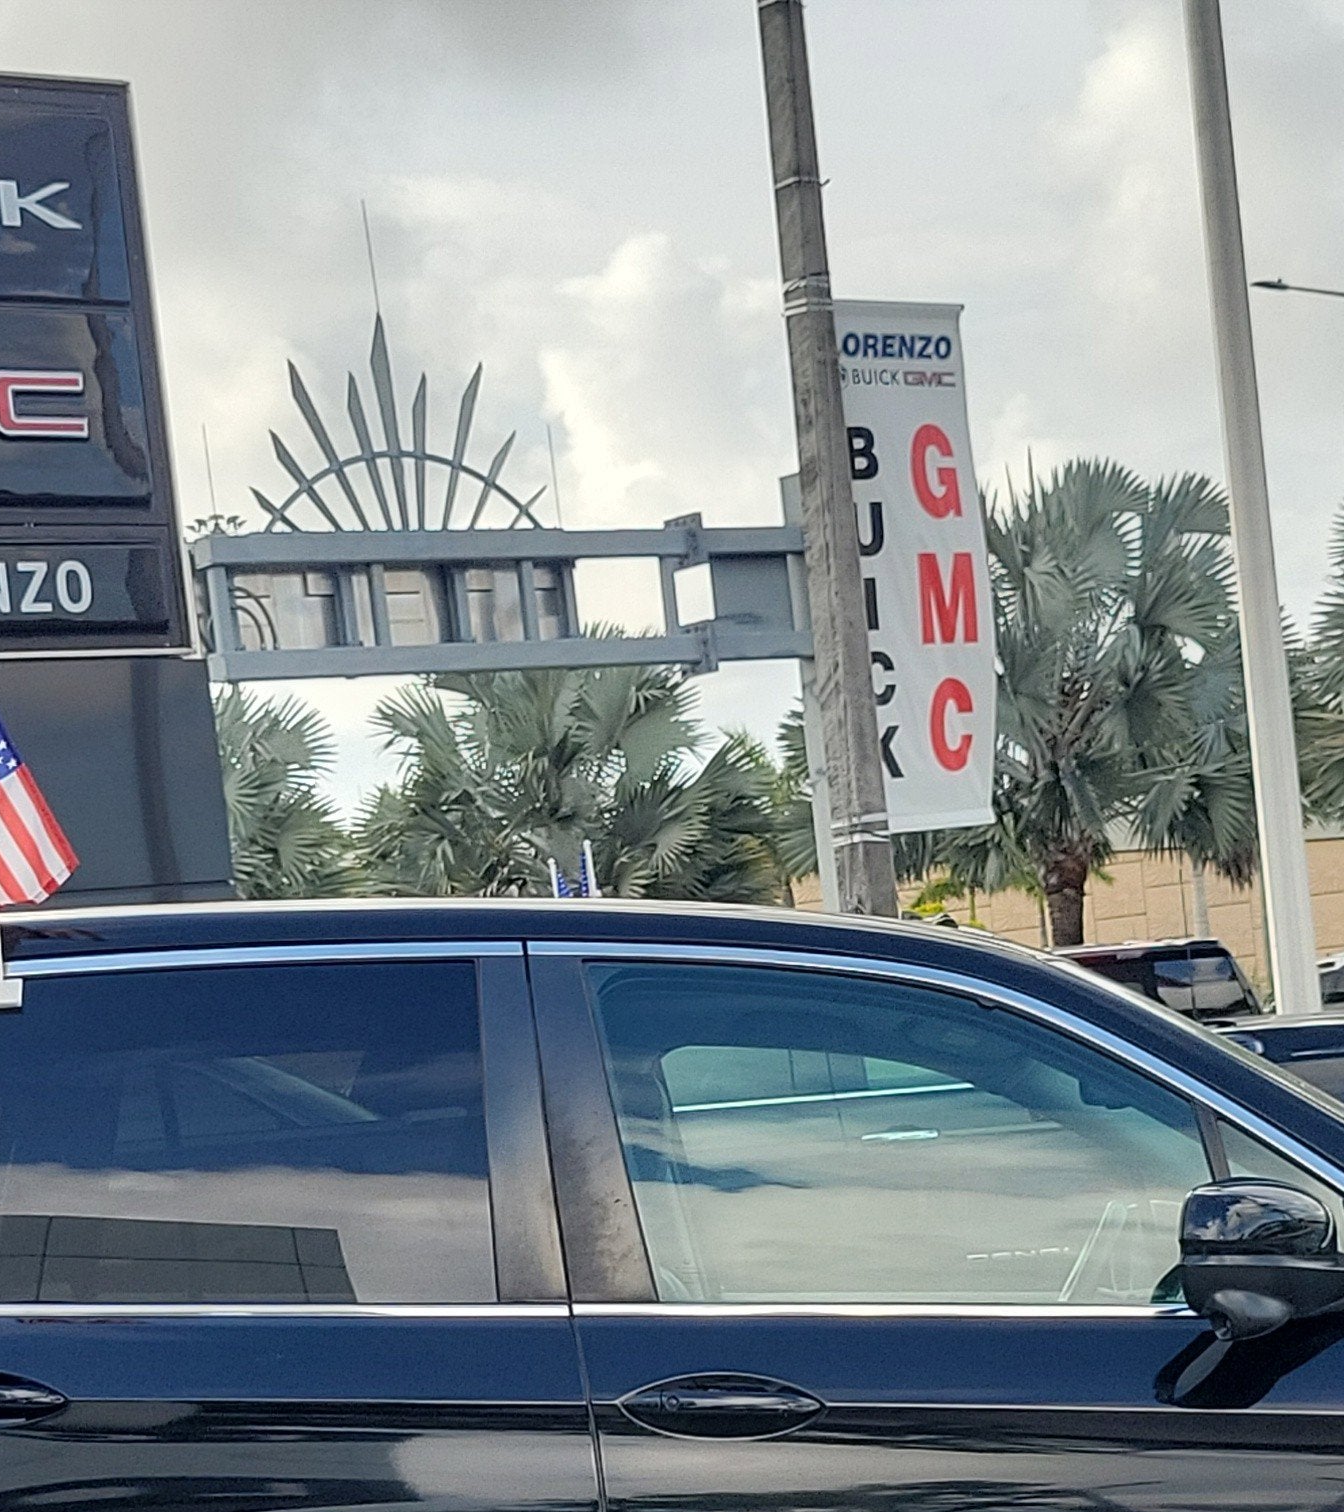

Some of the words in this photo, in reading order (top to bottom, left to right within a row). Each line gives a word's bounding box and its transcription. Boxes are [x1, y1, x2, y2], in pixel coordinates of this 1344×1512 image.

[839, 332, 953, 359] ORENZO
[851, 368, 900, 386] BUICK
[903, 370, 956, 388] GMC
[909, 423, 979, 773] GMC
